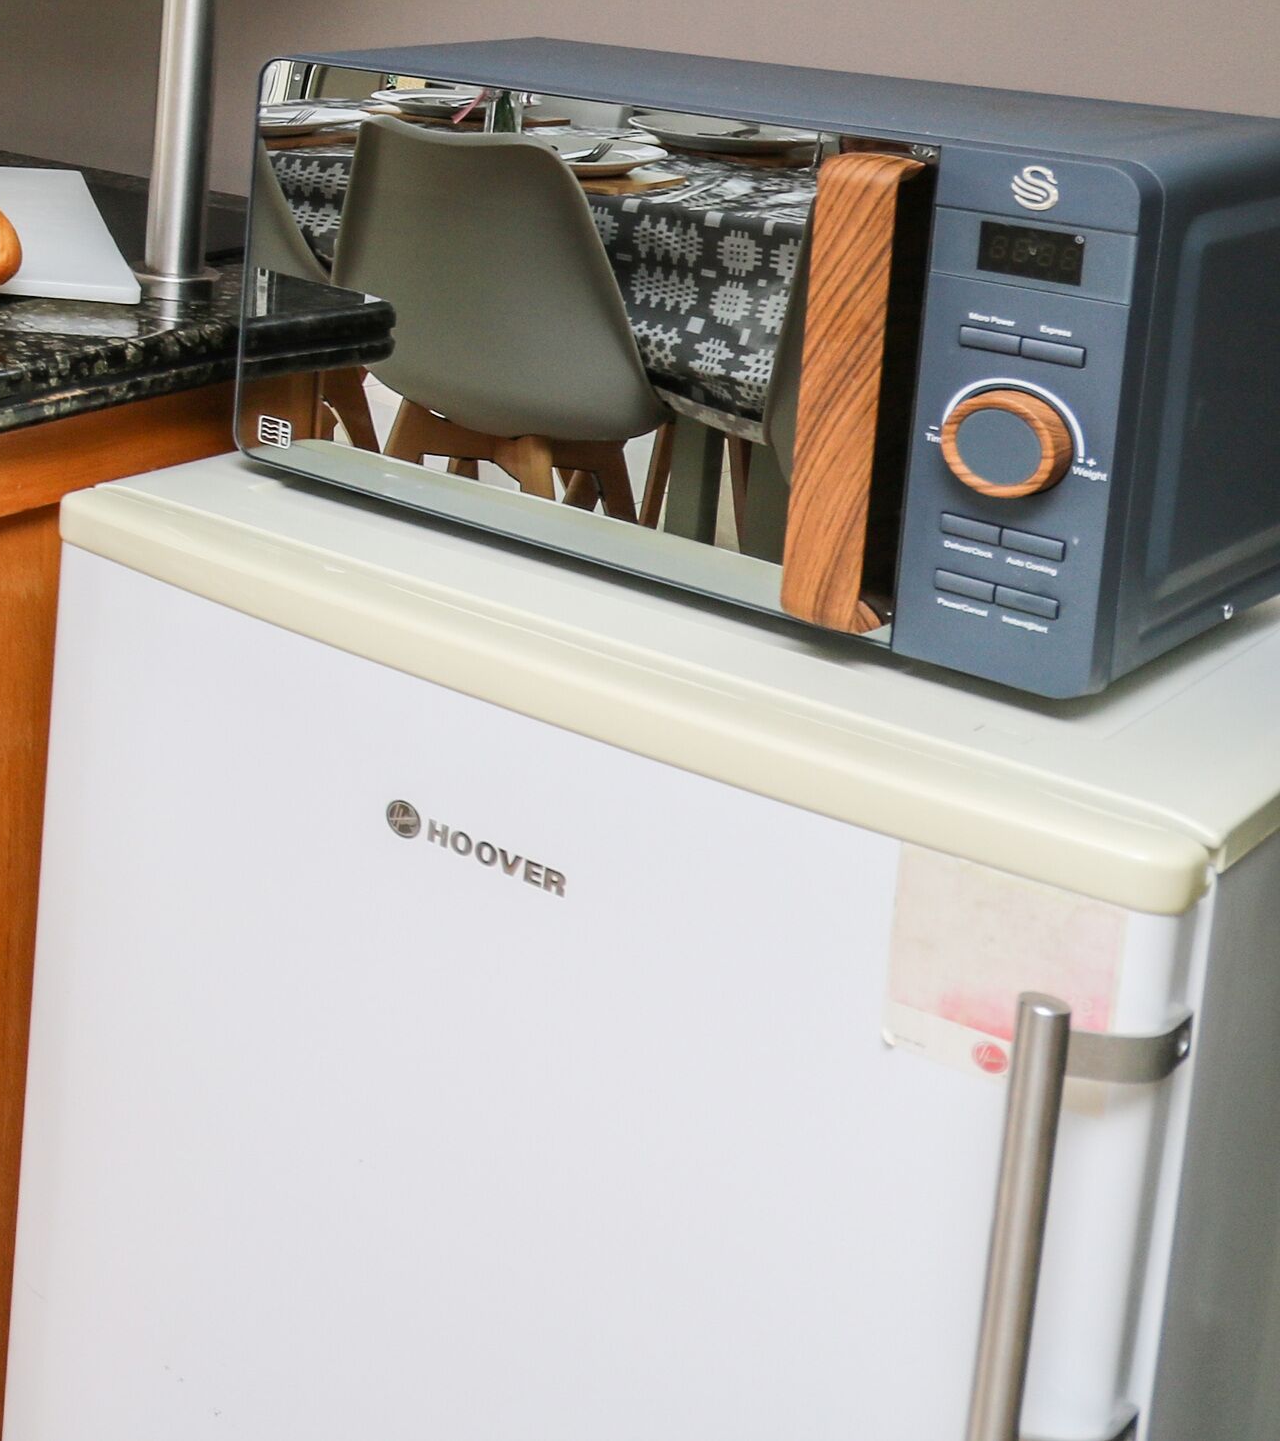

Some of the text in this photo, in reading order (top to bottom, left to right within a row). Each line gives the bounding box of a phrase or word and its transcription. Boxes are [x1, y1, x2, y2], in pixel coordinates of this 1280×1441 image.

[924, 431, 943, 444] Tim
[1071, 465, 1108, 483] Weight
[1025, 561, 1058, 577] Cooking
[426, 818, 567, 899] HOOVER
